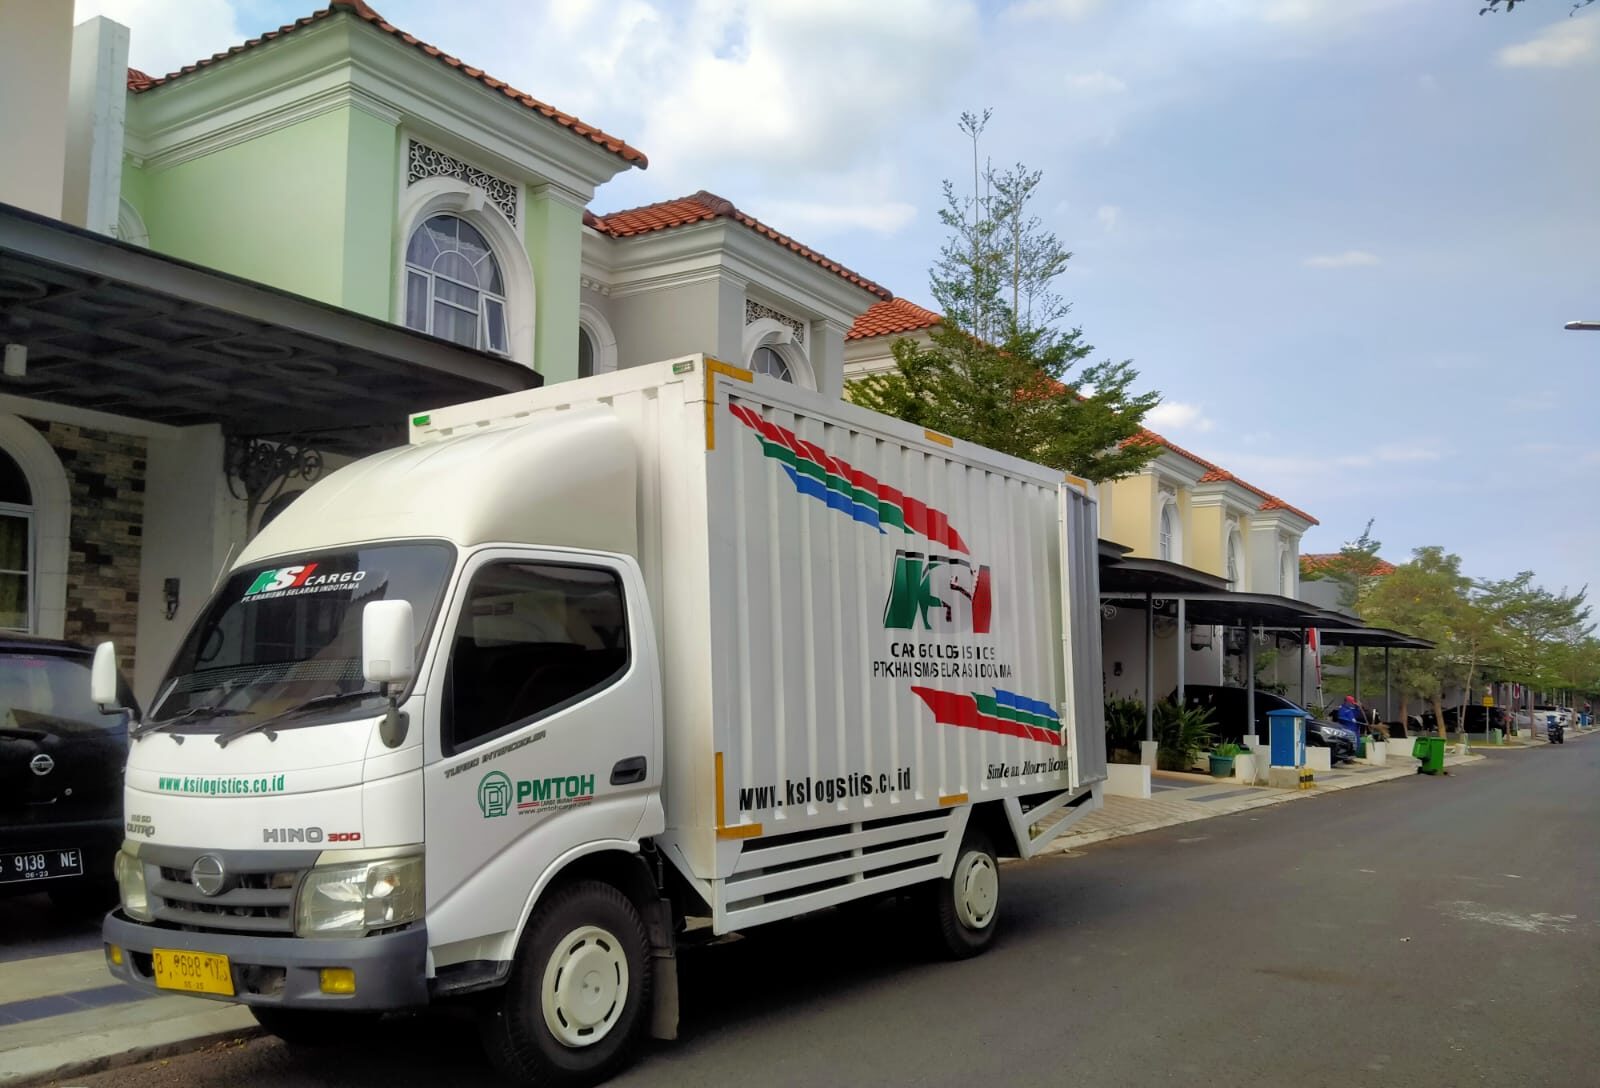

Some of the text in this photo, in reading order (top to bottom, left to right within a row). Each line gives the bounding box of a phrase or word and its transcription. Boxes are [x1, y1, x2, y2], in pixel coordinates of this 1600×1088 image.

[245, 563, 366, 596] KSI CARGO
[251, 589, 286, 601] KHARISMA
[286, 586, 318, 596] SELARAS
[319, 582, 360, 593] INDOTAMA
[444, 757, 480, 778] TURBO
[158, 774, 285, 796] www.ksilogistics.co.id
[517, 774, 595, 803] PMTOH
[263, 827, 361, 843] HINO 300
[14, 854, 46, 872] 9138
[60, 851, 78, 868] NE
